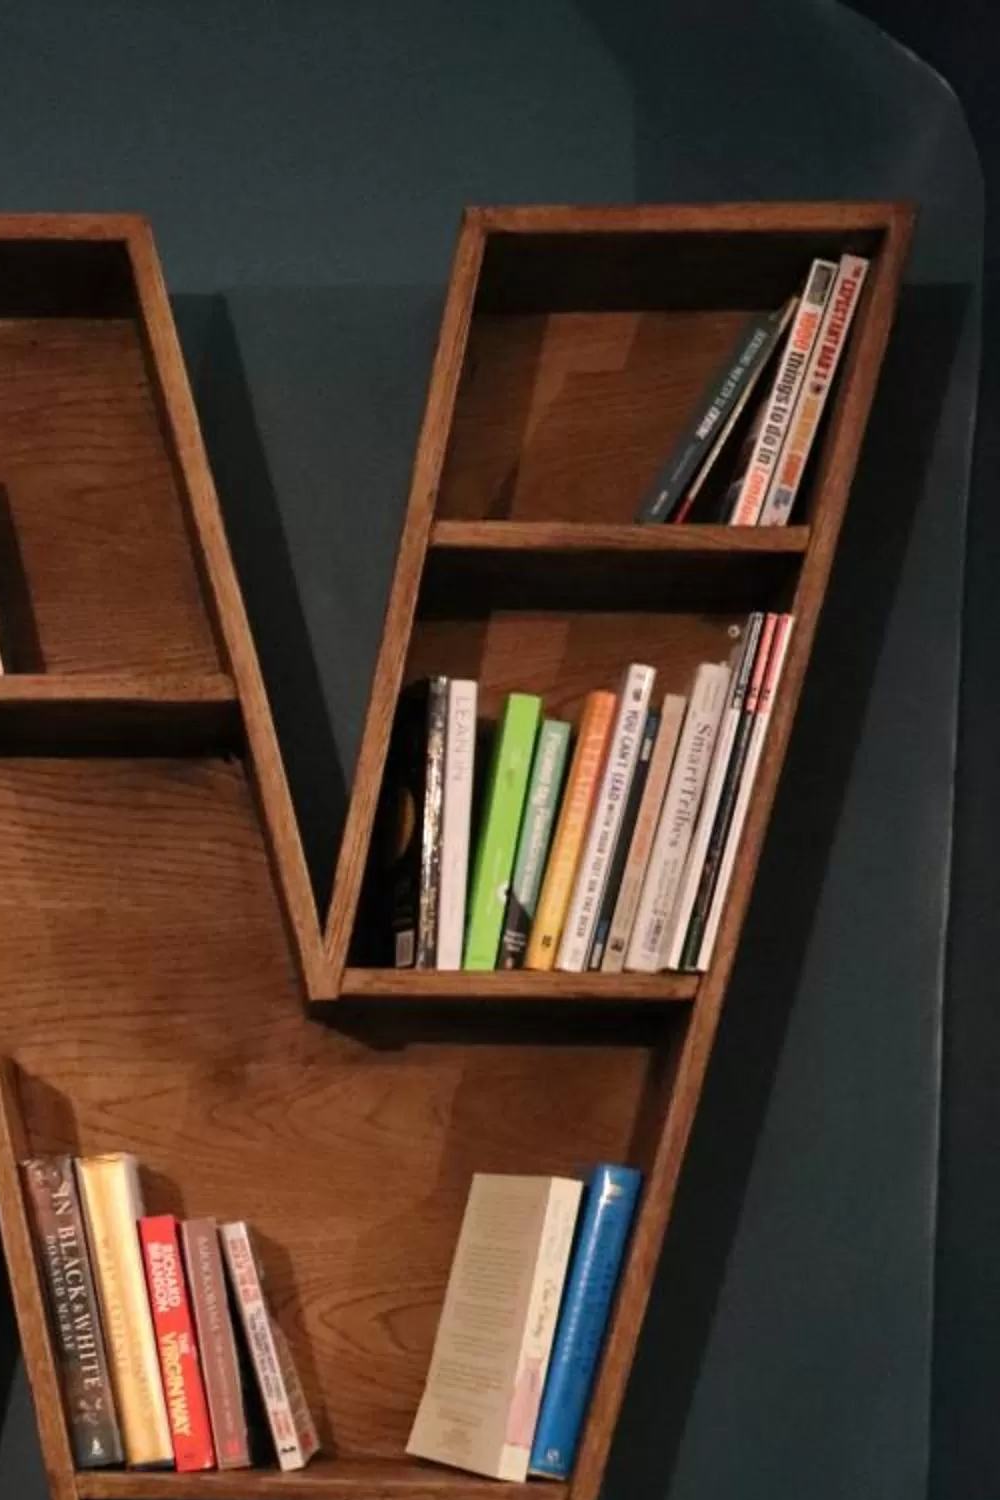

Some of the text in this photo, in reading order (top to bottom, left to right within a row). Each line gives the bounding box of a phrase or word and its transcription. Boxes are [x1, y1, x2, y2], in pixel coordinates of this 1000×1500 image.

[774, 351, 803, 404] things
[763, 423, 782, 446] do
[770, 405, 787, 424] to
[757, 447, 774, 465] in
[615, 735, 632, 767] CAN'T
[608, 772, 623, 800] LEAD
[145, 1240, 170, 1312] BRANSON
[159, 1242, 183, 1307] RICHARD
[56, 1226, 88, 1298] BLACK
[72, 1315, 101, 1389] WHITE
[157, 1332, 190, 1437] VIRGIN WAY
